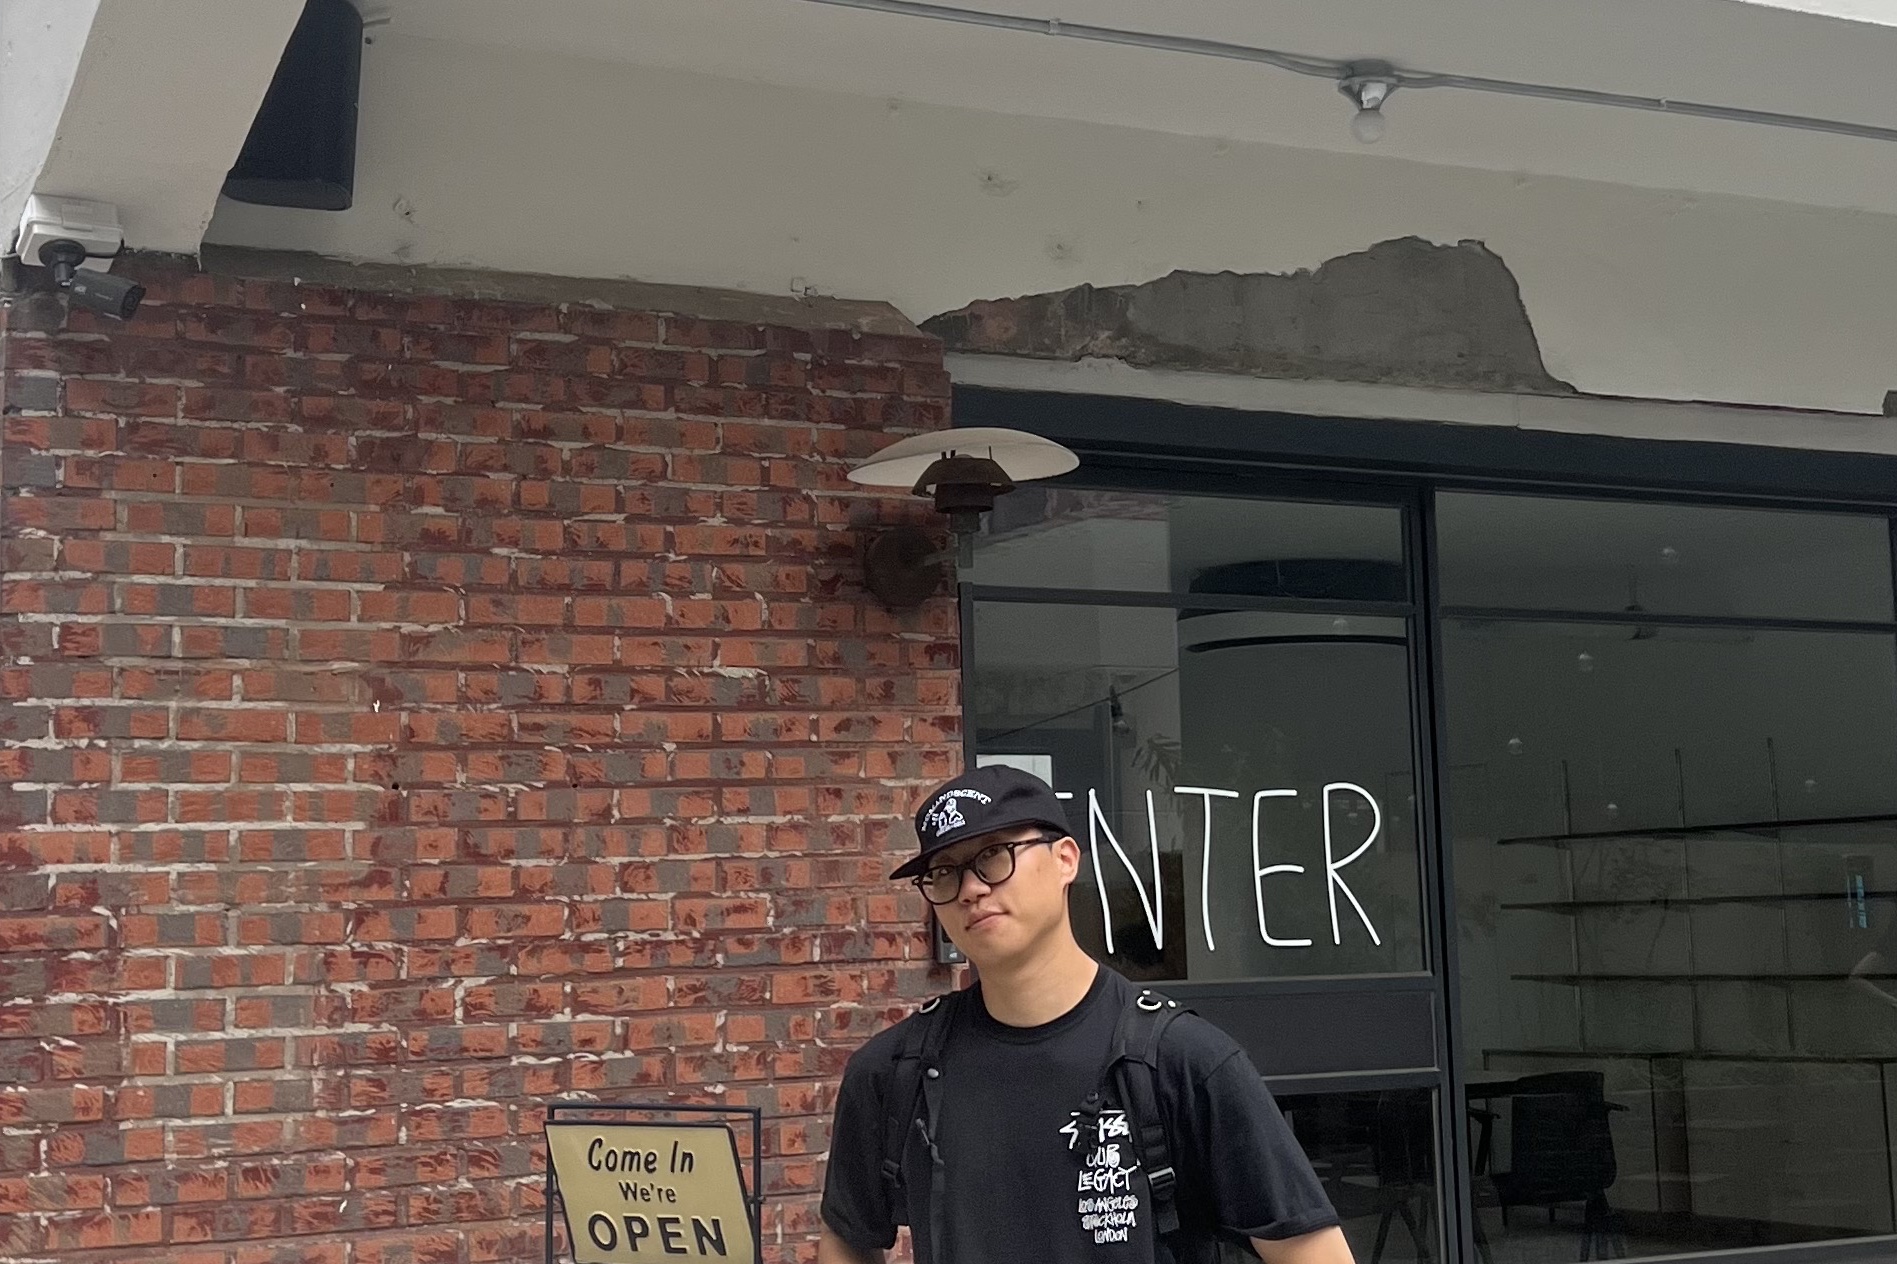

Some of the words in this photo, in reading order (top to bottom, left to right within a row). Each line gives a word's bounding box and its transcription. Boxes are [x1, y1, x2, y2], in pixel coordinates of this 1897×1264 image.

[1055, 782, 1382, 955] NTER
[588, 1136, 658, 1174] Come
[669, 1139, 695, 1174] In
[618, 1179, 678, 1204] We're
[1077, 1165, 1138, 1194] LEGACY
[587, 1211, 728, 1257] OPEN
[1094, 1226, 1128, 1244] LONDON
